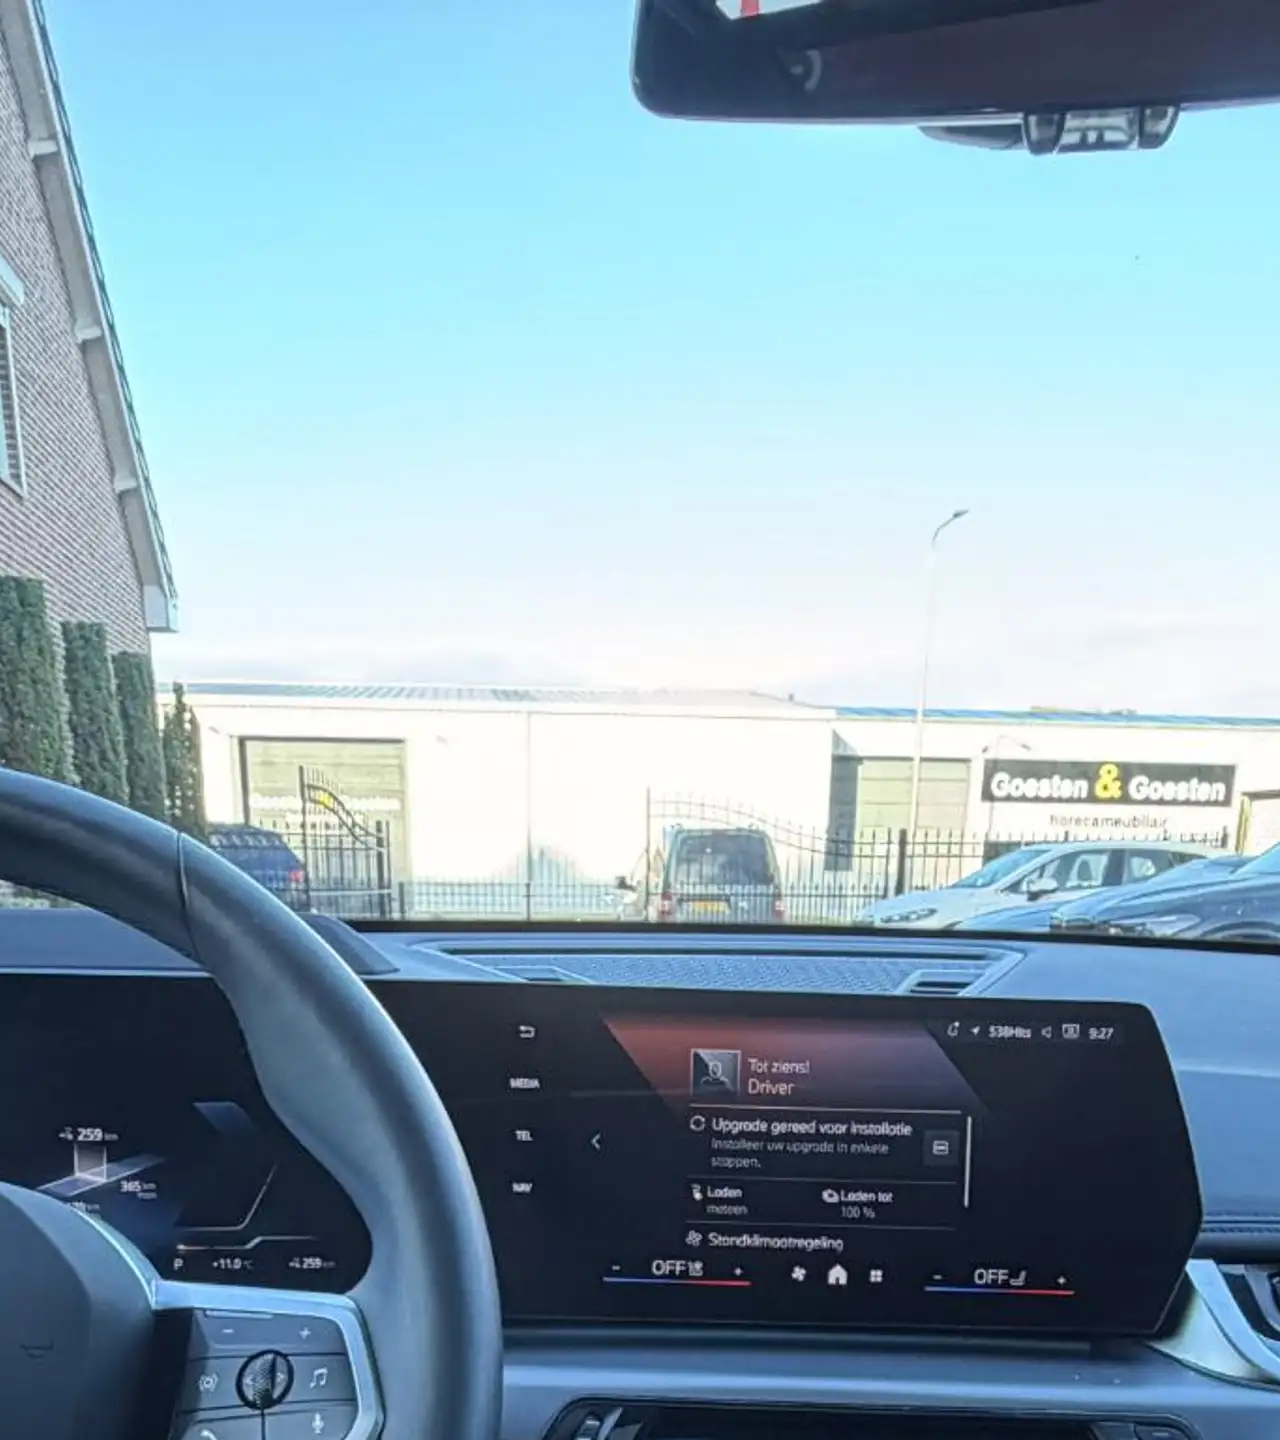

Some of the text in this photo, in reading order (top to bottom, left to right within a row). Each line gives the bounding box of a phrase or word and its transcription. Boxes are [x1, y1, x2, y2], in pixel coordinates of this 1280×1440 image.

[990, 763, 1227, 802] Goesten & Goesten
[1050, 814, 1169, 829] horecameubilair
[748, 1058, 810, 1074] Tot ziens!
[509, 1078, 540, 1089] MEDIA
[748, 1078, 795, 1096] Driver
[712, 1118, 768, 1135] Upgrade
[771, 1120, 816, 1136] gereed
[819, 1123, 847, 1135] voor
[515, 1130, 533, 1141] TEL
[787, 1140, 835, 1154] upgrade
[512, 1182, 533, 1193] NAV
[707, 1186, 743, 1198] Laden
[840, 1190, 893, 1202] Laden tot
[841, 1206, 876, 1218] 100 %
[173, 1258, 184, 1271] P
[651, 1260, 686, 1276] OFF
[974, 1268, 1009, 1285] OFF
